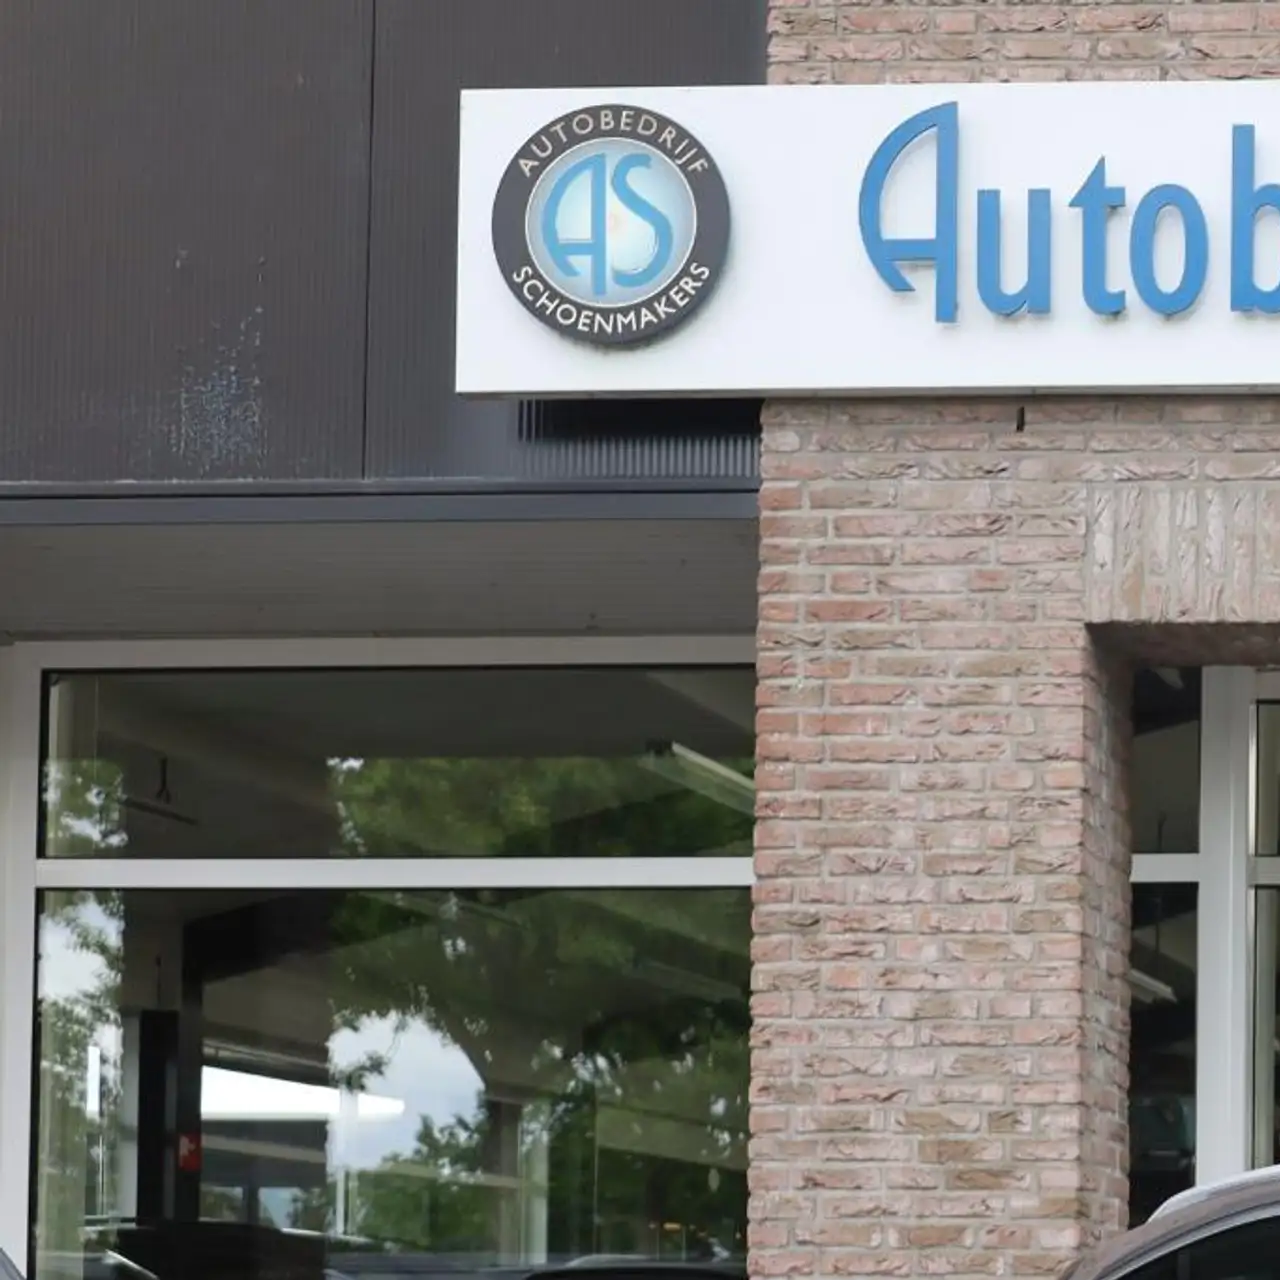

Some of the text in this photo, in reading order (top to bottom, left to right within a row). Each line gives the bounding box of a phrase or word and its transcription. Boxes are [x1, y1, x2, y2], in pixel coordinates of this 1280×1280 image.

[518, 110, 708, 177] AUTOBEDRIJF
[541, 152, 673, 295] AS
[512, 262, 710, 335] SCHOENMAKERS
